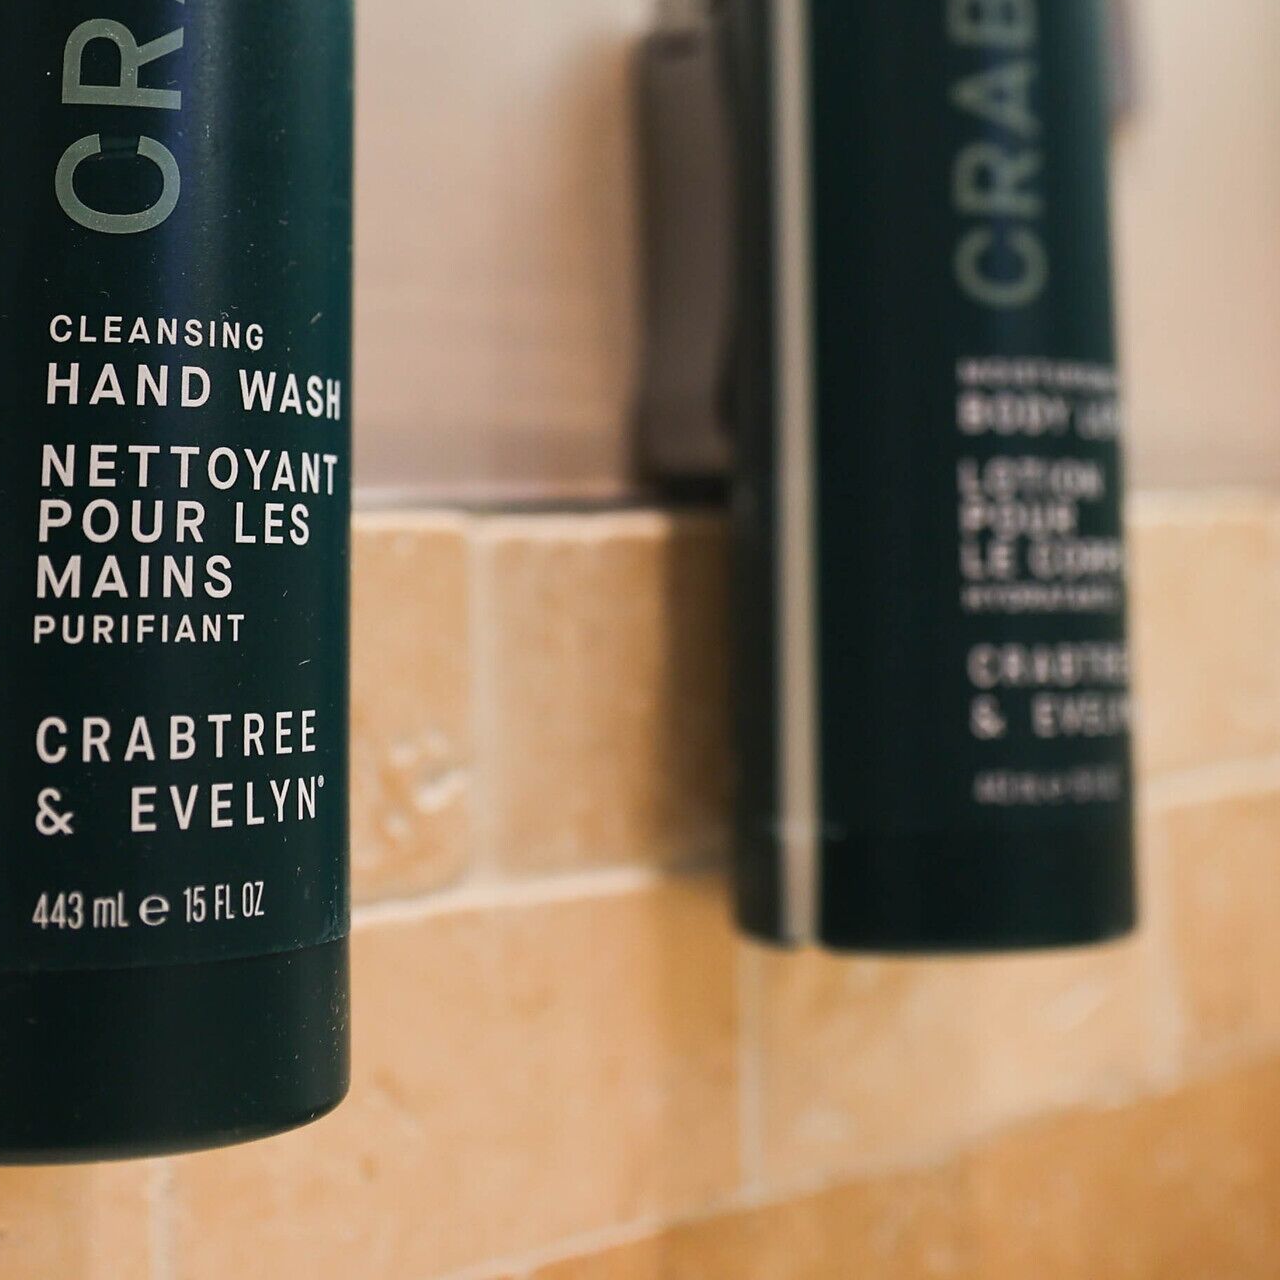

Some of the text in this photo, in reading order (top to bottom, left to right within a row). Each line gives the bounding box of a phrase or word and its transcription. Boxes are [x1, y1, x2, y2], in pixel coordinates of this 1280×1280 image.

[49, 314, 264, 351] CLEANSING
[46, 362, 341, 421] HAND WASH
[41, 444, 338, 496] NETTOYANT
[38, 498, 310, 546] POUR LES
[36, 554, 233, 599] MAINS
[33, 613, 245, 645] PURIFIANT
[36, 709, 317, 764] CRABTREE
[35, 787, 74, 836] &
[32, 892, 84, 930] 443
[183, 885, 206, 923] 15
[214, 884, 235, 921] FL
[242, 880, 265, 918] OZ
